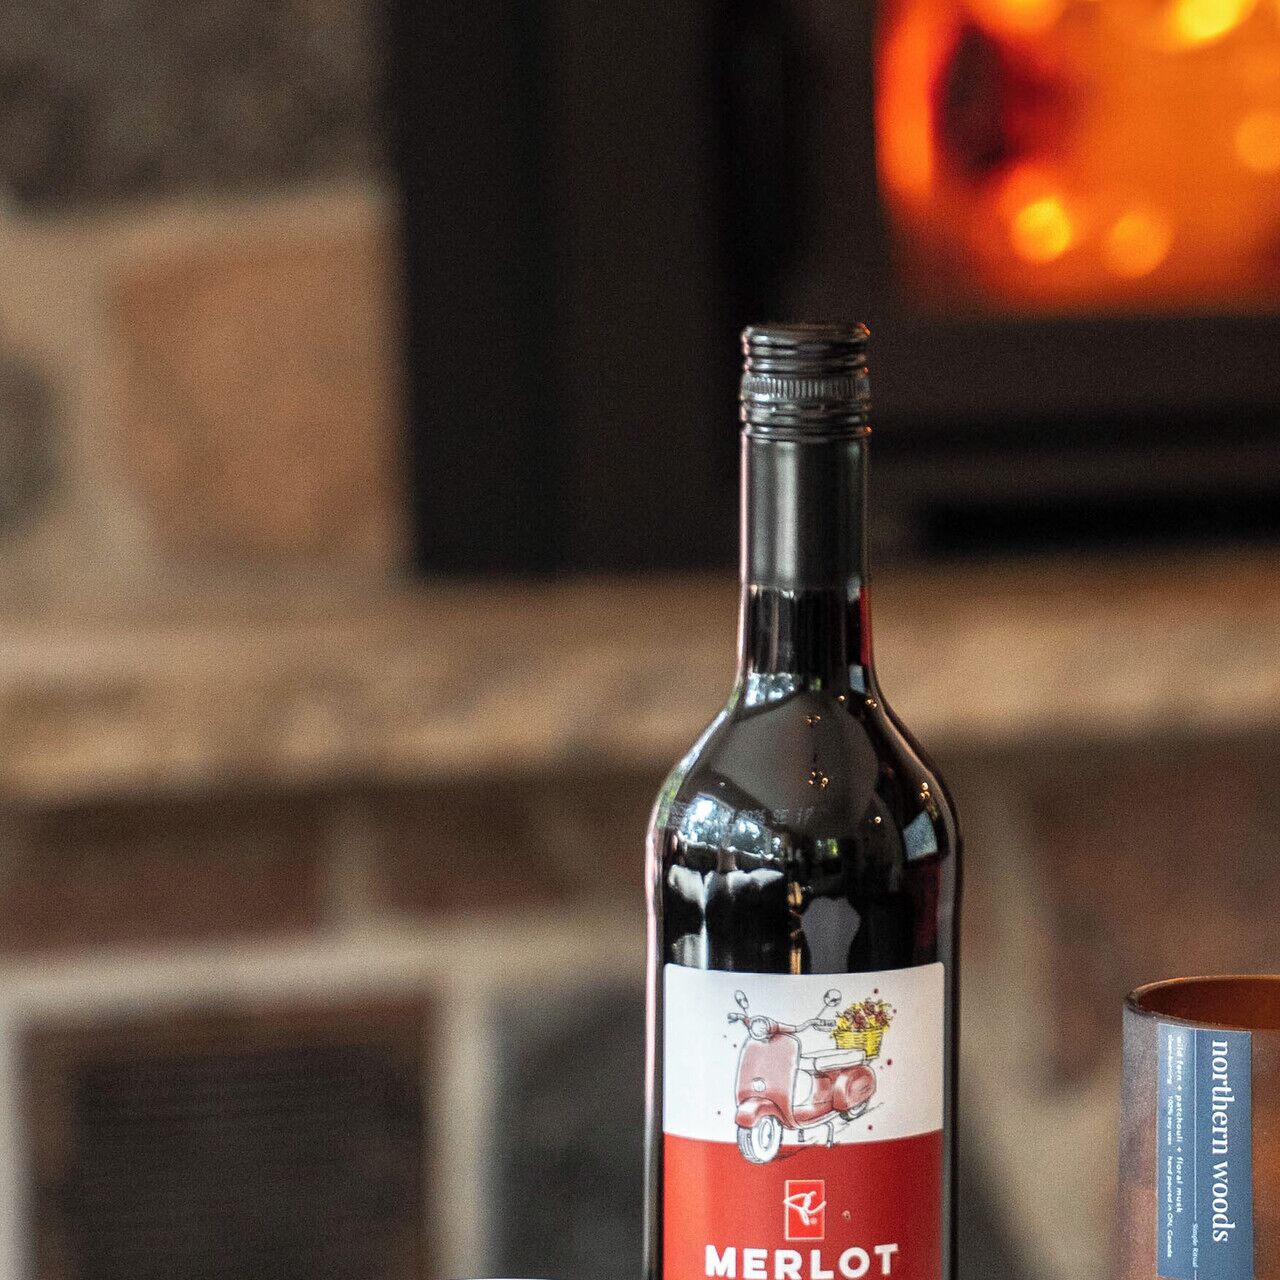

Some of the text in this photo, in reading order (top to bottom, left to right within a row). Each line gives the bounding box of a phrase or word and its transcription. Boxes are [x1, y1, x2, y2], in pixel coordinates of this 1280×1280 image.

[1176, 1035, 1184, 1058] wild
[1176, 1061, 1184, 1081] fern
[1175, 1094, 1184, 1142] patchouli
[1212, 1040, 1236, 1242] northern woods
[1176, 1156, 1184, 1184] floral
[1176, 1187, 1184, 1213] musk
[704, 1243, 899, 1280] MERLOT
